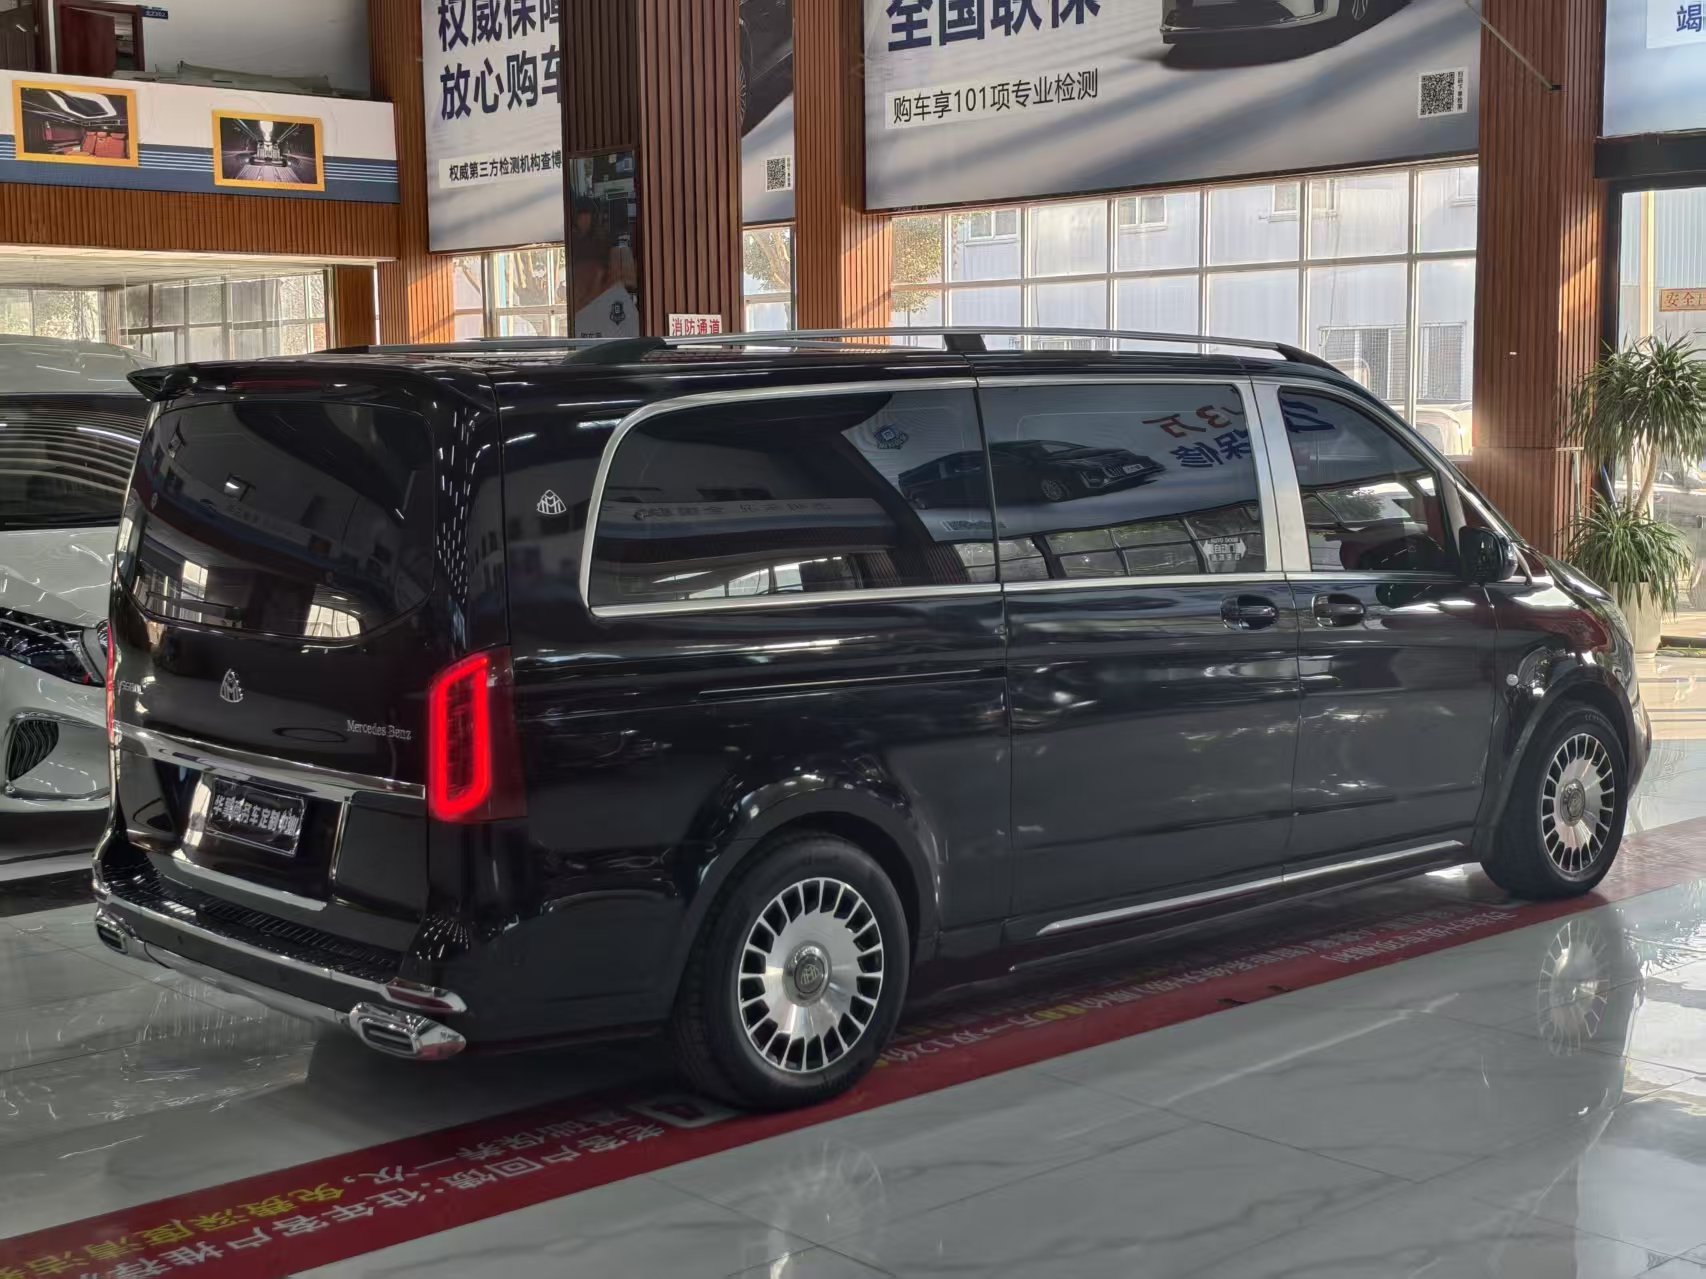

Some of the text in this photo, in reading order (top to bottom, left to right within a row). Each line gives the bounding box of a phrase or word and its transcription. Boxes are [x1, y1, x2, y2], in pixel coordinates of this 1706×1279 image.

[1676, 4, 1706, 32] 竭
[893, 68, 1098, 124] 购车享101项专业检测
[449, 150, 562, 182] 权威第三方检测机构查博
[1665, 291, 1704, 307] 安全
[672, 318, 720, 336] 消防通道
